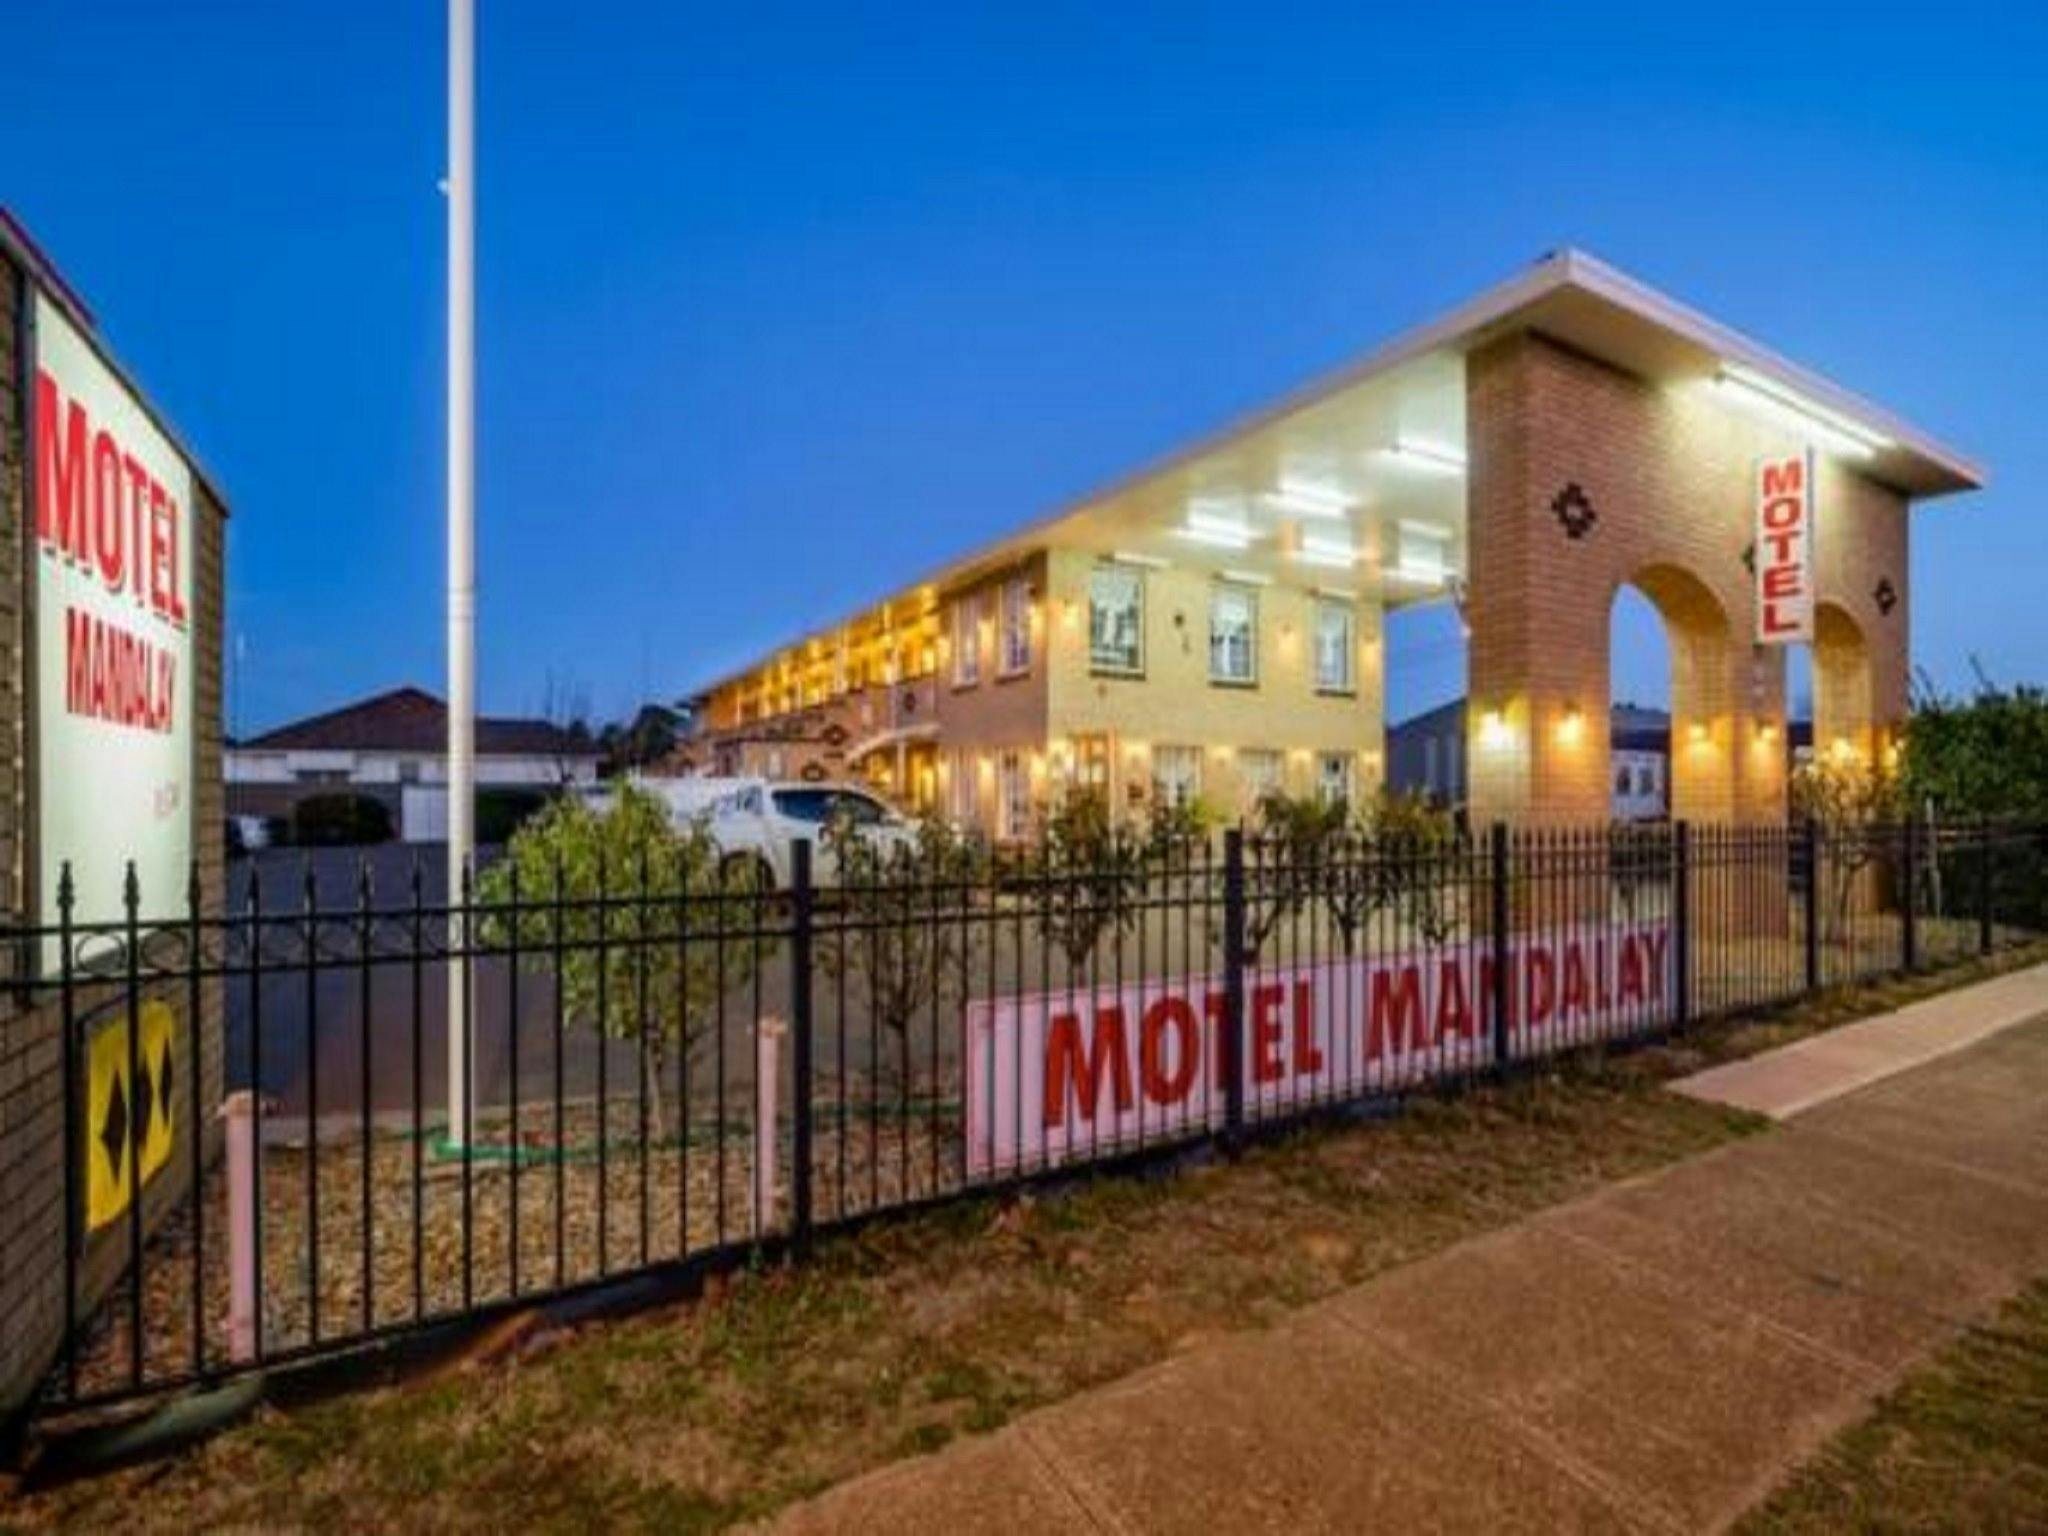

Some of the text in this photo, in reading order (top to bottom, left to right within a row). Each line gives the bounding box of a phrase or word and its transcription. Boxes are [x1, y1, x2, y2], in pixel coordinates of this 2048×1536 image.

[37, 370, 185, 622] MOTEL
[1763, 458, 1801, 632] MOTEL
[67, 607, 174, 731] MANDALAY
